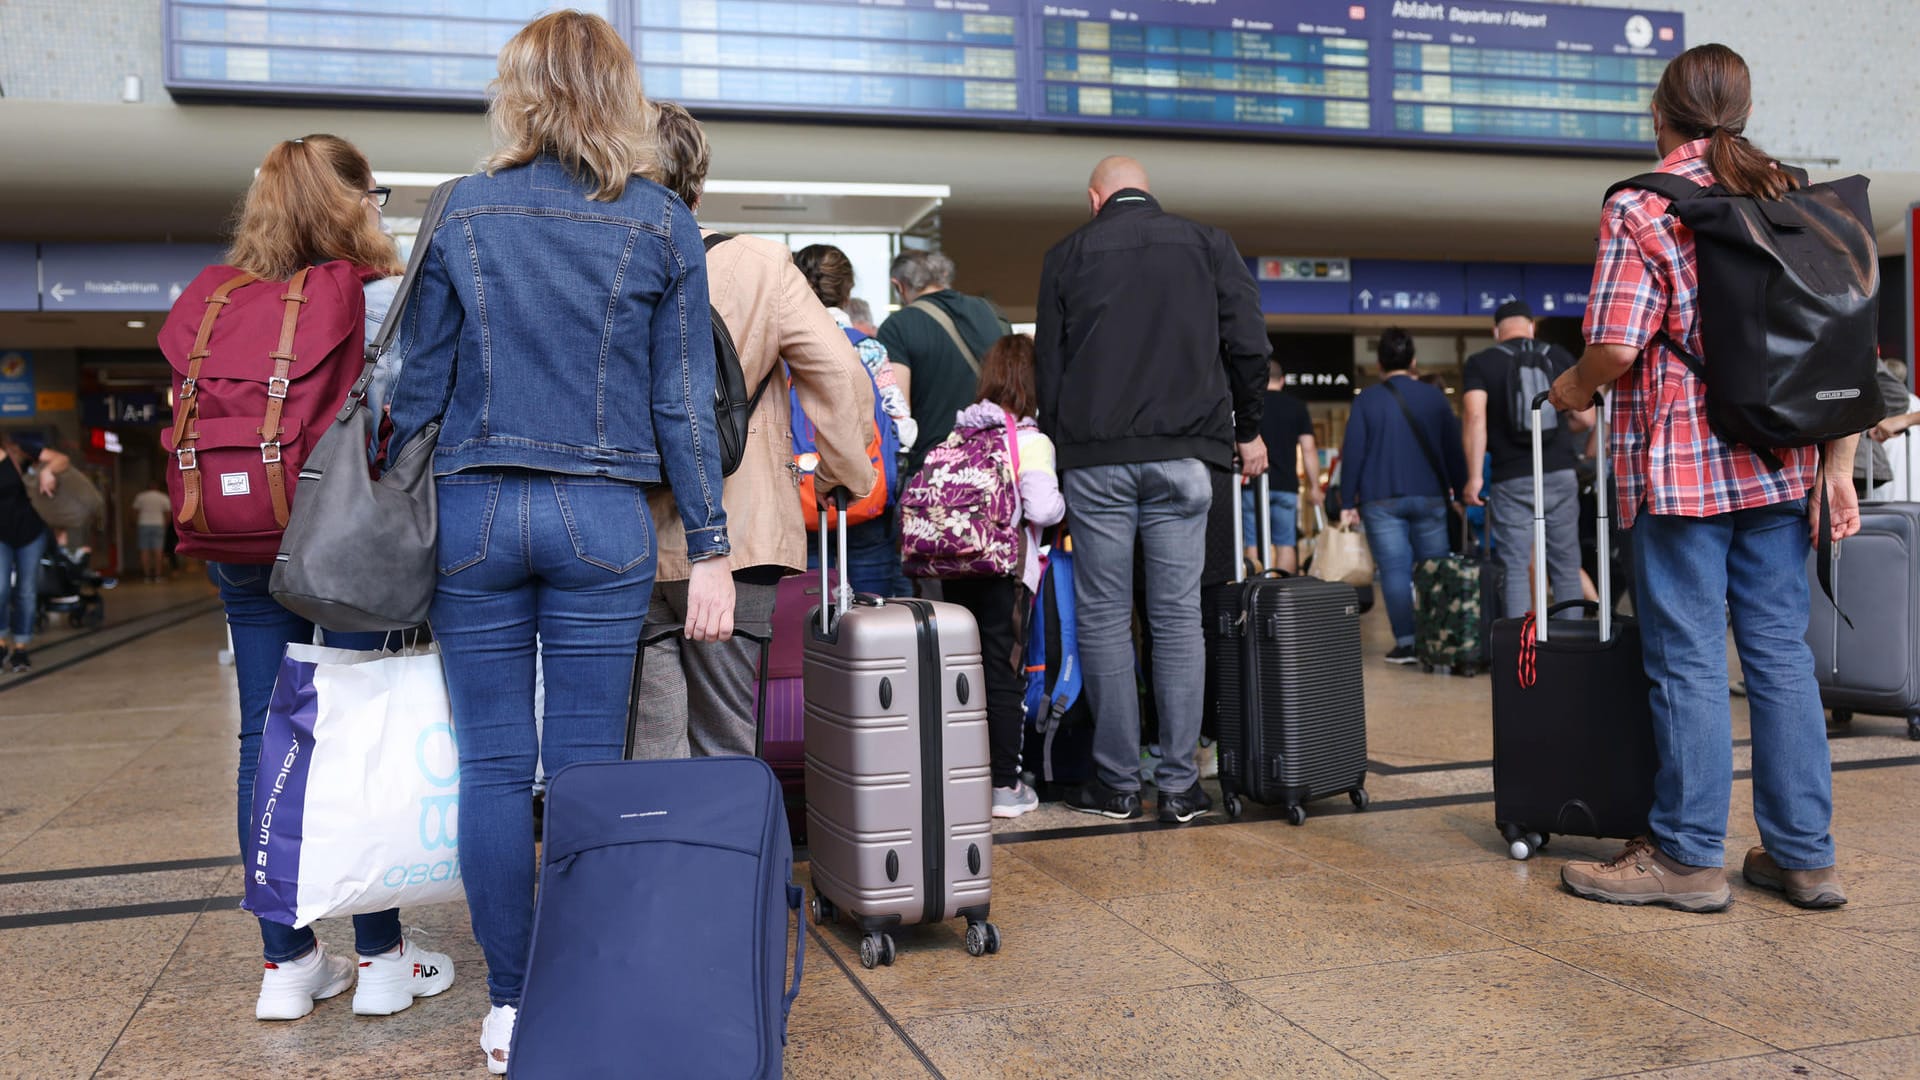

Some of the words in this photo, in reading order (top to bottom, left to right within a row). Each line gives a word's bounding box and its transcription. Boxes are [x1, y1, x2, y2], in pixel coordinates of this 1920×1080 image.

[1392, 0, 1445, 20] Abfahrt
[1449, 7, 1503, 24] Departure
[1285, 373, 1349, 386] ERNA
[412, 963, 439, 979] FILA
